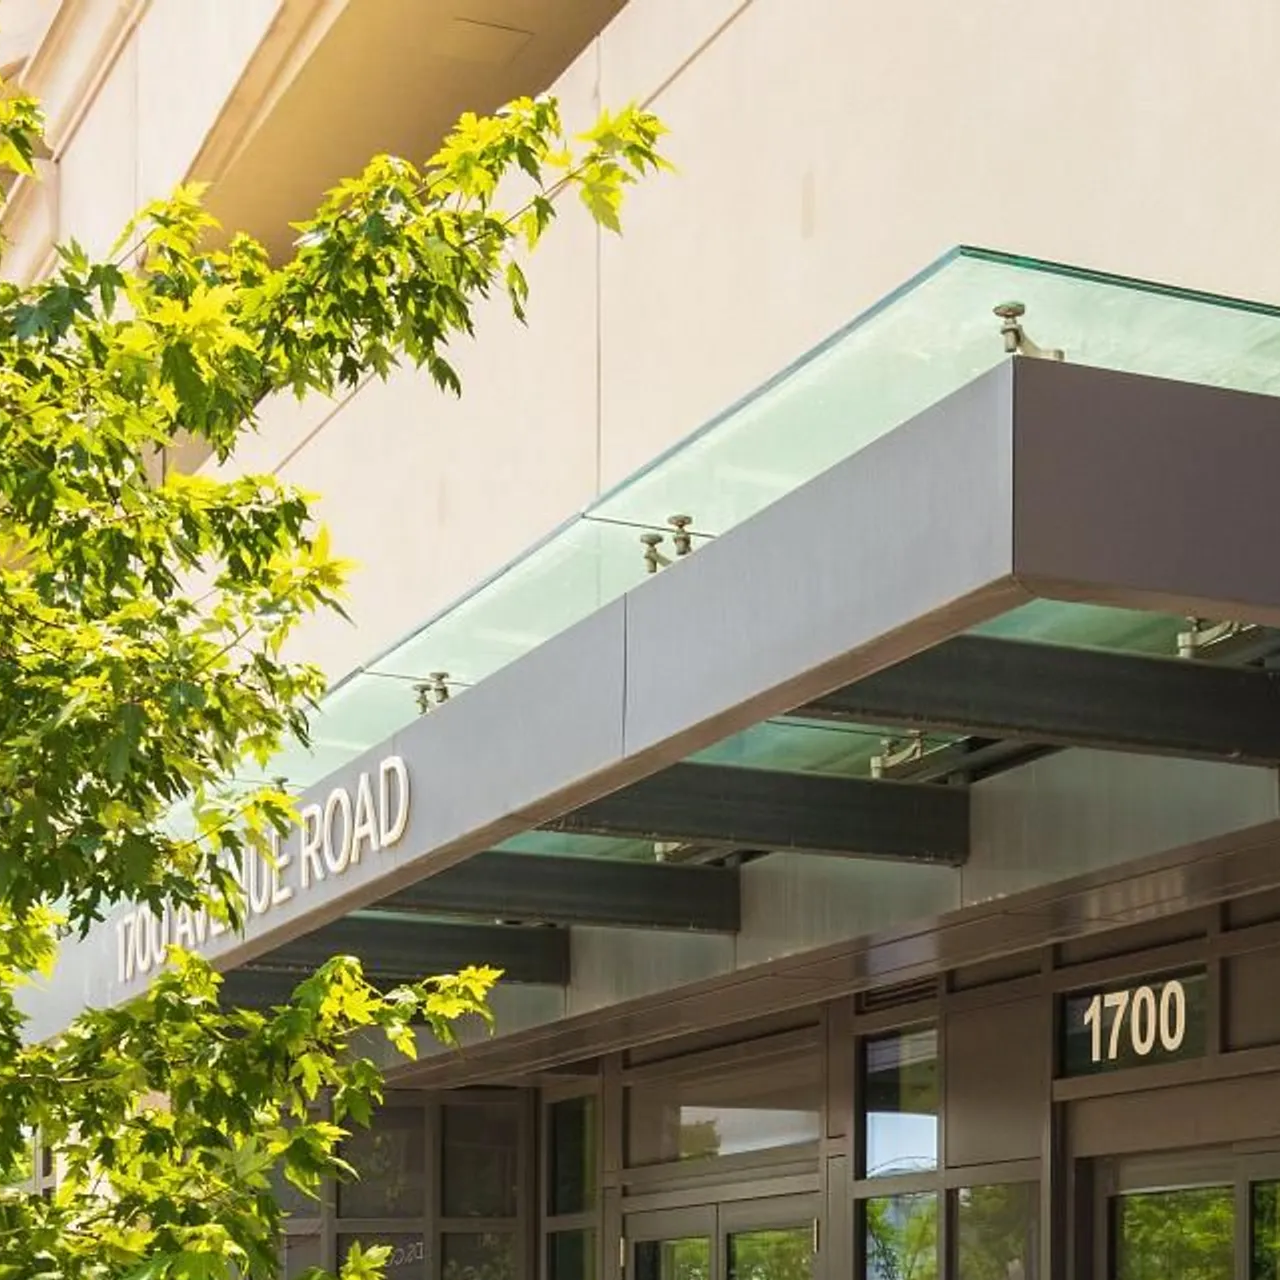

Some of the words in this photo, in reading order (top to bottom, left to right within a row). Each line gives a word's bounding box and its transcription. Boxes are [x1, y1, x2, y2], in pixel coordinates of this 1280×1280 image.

[117, 897, 170, 982] 1700
[301, 756, 410, 889] ROAD
[1083, 979, 1186, 1062] 1700
